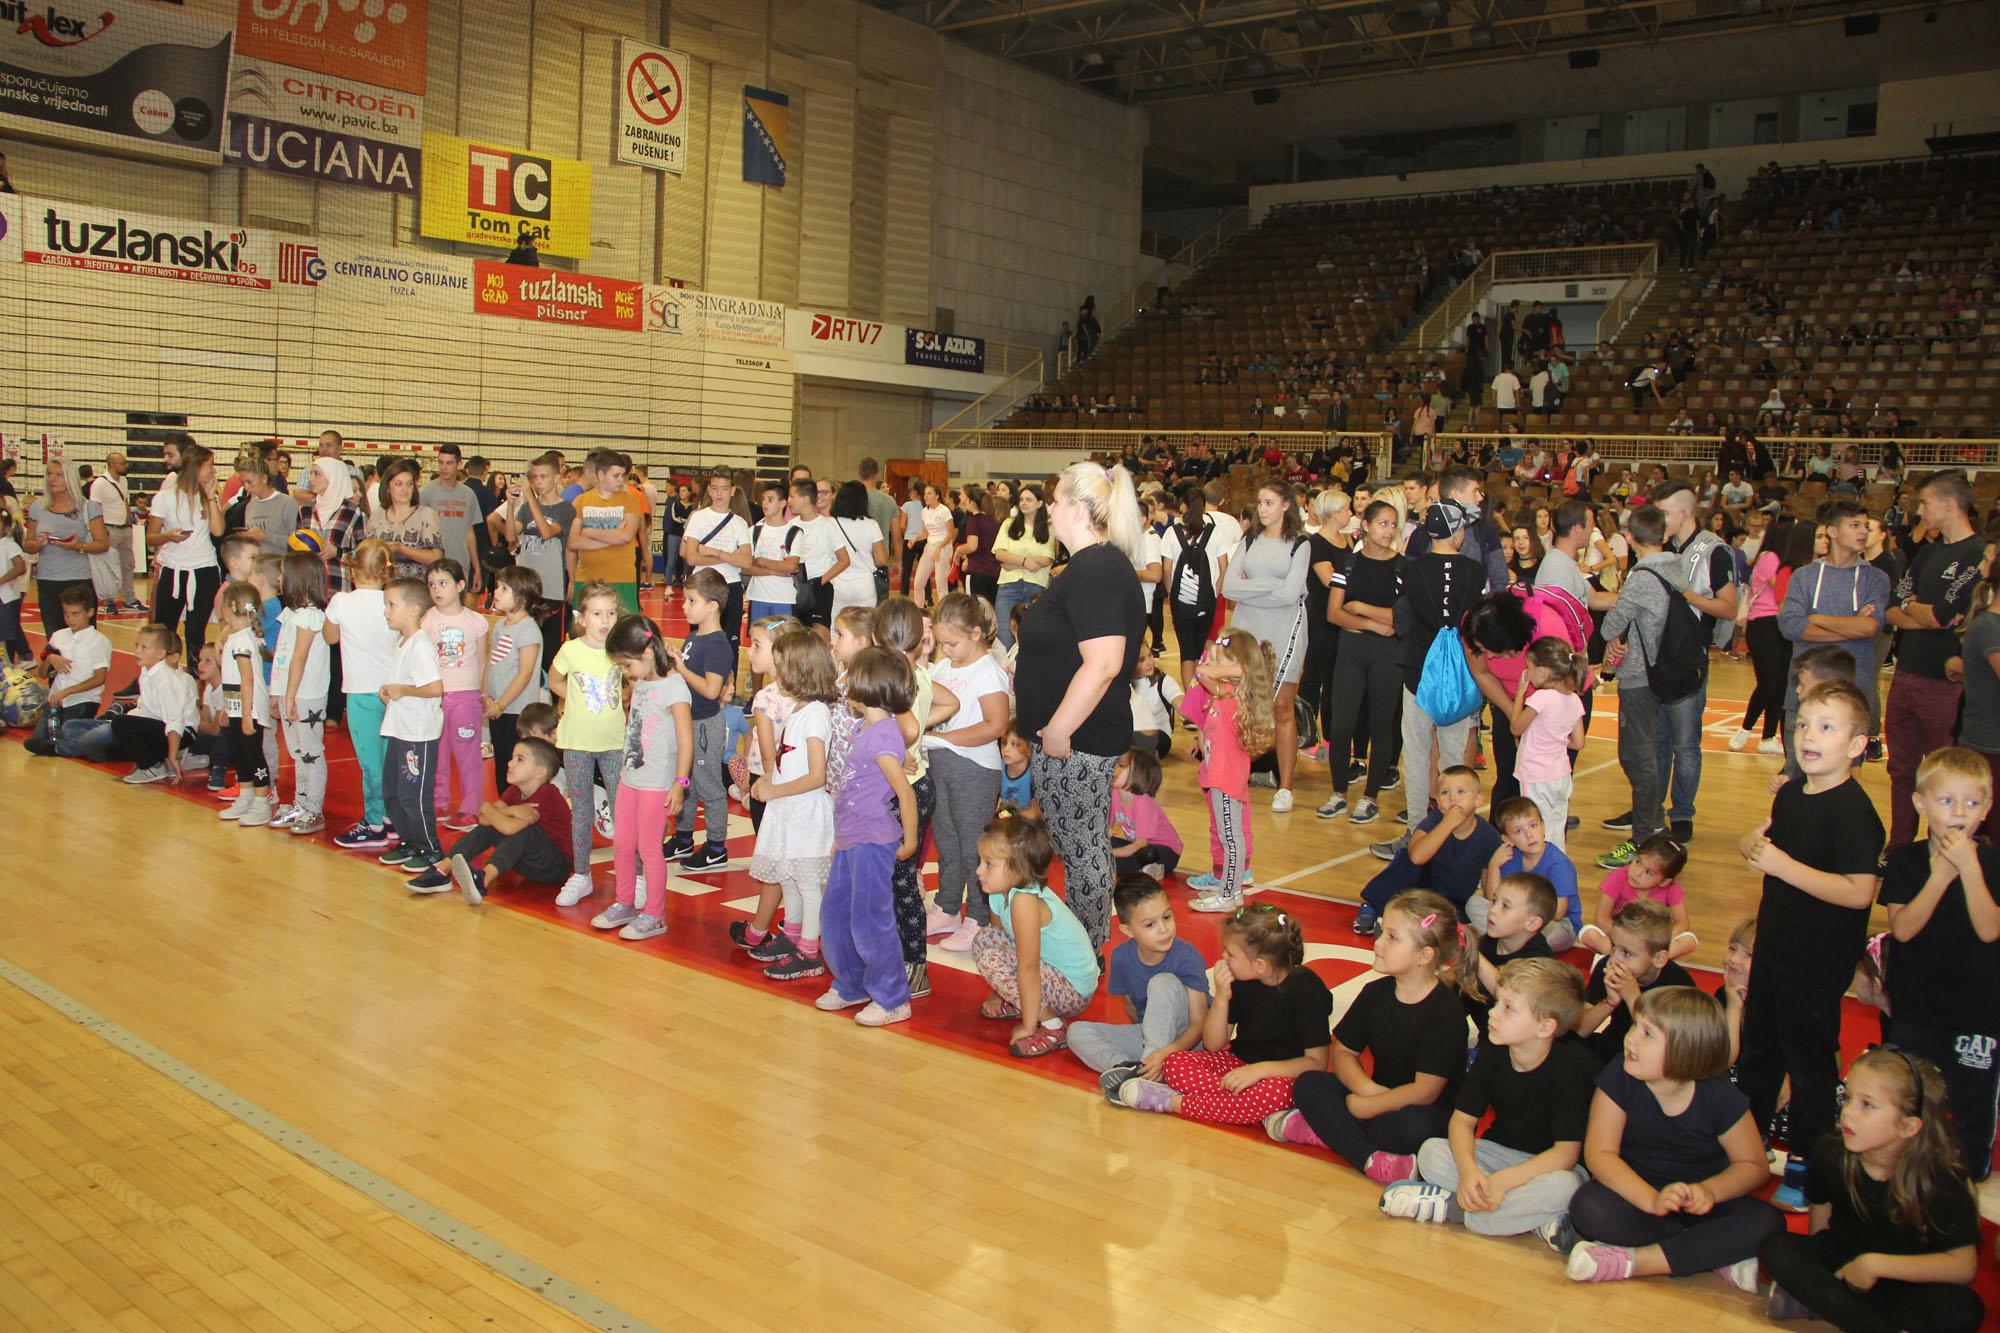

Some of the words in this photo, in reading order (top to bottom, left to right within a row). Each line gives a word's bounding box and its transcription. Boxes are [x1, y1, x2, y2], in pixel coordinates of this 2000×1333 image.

[251, 23, 268, 36] BH
[272, 27, 326, 50] TELECOM
[350, 46, 406, 68] SARAJEVO
[43, 96, 108, 117] vrijednosti
[140, 106, 169, 118] Canon
[300, 106, 399, 135] www.pavic.ba
[625, 125, 681, 148] ZABRANJENO
[224, 119, 414, 189] LUCIANA
[471, 151, 549, 213] TC
[468, 212, 510, 235] Tom
[518, 220, 551, 241] Cat
[43, 207, 239, 272] tuzlanski
[40, 255, 72, 267] ČARŠIJA
[84, 259, 120, 272] INFOTEKA
[236, 277, 258, 287] SPORT
[334, 260, 409, 283] CENTRALNO
[412, 270, 469, 290] GRIJANJE
[487, 273, 504, 289] MOJ
[389, 285, 417, 297] TUZLA
[482, 288, 509, 305] GRAD
[519, 272, 604, 309] tuzlanski
[615, 290, 635, 305] MOJE
[537, 303, 588, 321] pilsner
[616, 305, 634, 319] PIVO
[696, 294, 782, 320] SINGRADNJA
[832, 318, 883, 345] RTV7
[915, 331, 941, 351] SOL
[944, 336, 977, 356] AZUR
[735, 358, 763, 367] TELESKOP
[915, 351, 941, 362] TRAVEL
[951, 356, 977, 367] EVENTS
[1178, 563, 1200, 605] NIKE
[1955, 1034, 1998, 1058] GAP
